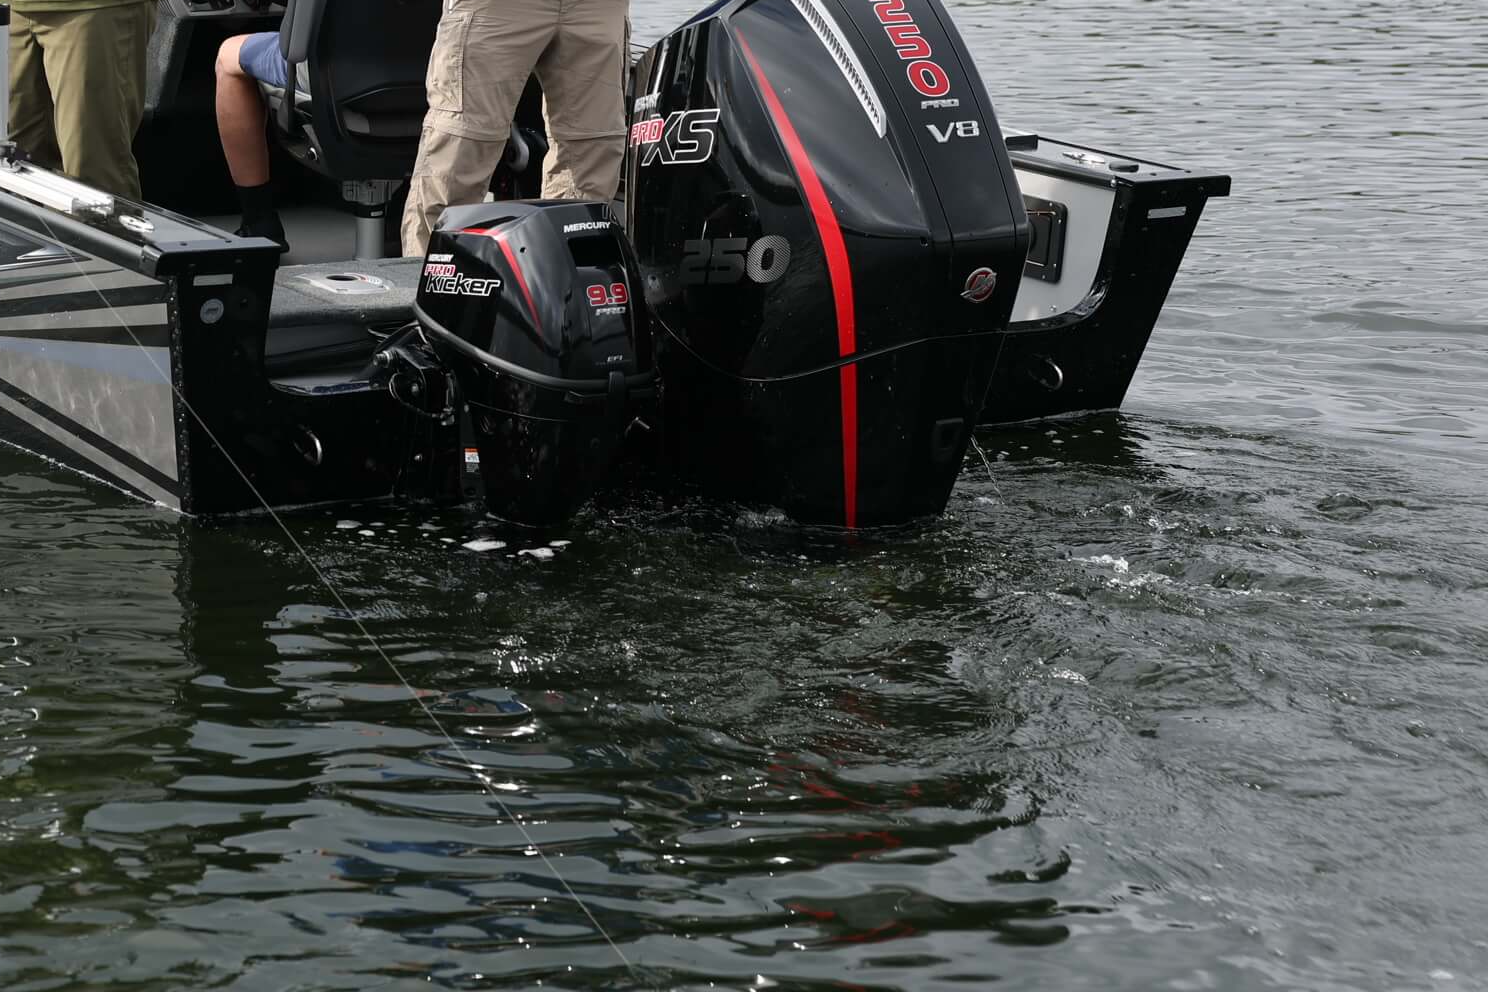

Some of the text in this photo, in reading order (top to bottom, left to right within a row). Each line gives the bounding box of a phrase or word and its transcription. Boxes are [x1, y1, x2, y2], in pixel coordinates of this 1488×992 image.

[921, 99, 960, 110] PRO
[629, 108, 720, 167] PRO XS
[925, 120, 980, 143] V8
[563, 221, 611, 233] MERCURY
[680, 234, 791, 285] 250
[424, 263, 456, 276] PRO
[586, 282, 628, 306] 9.9
[595, 306, 626, 316] PRO
